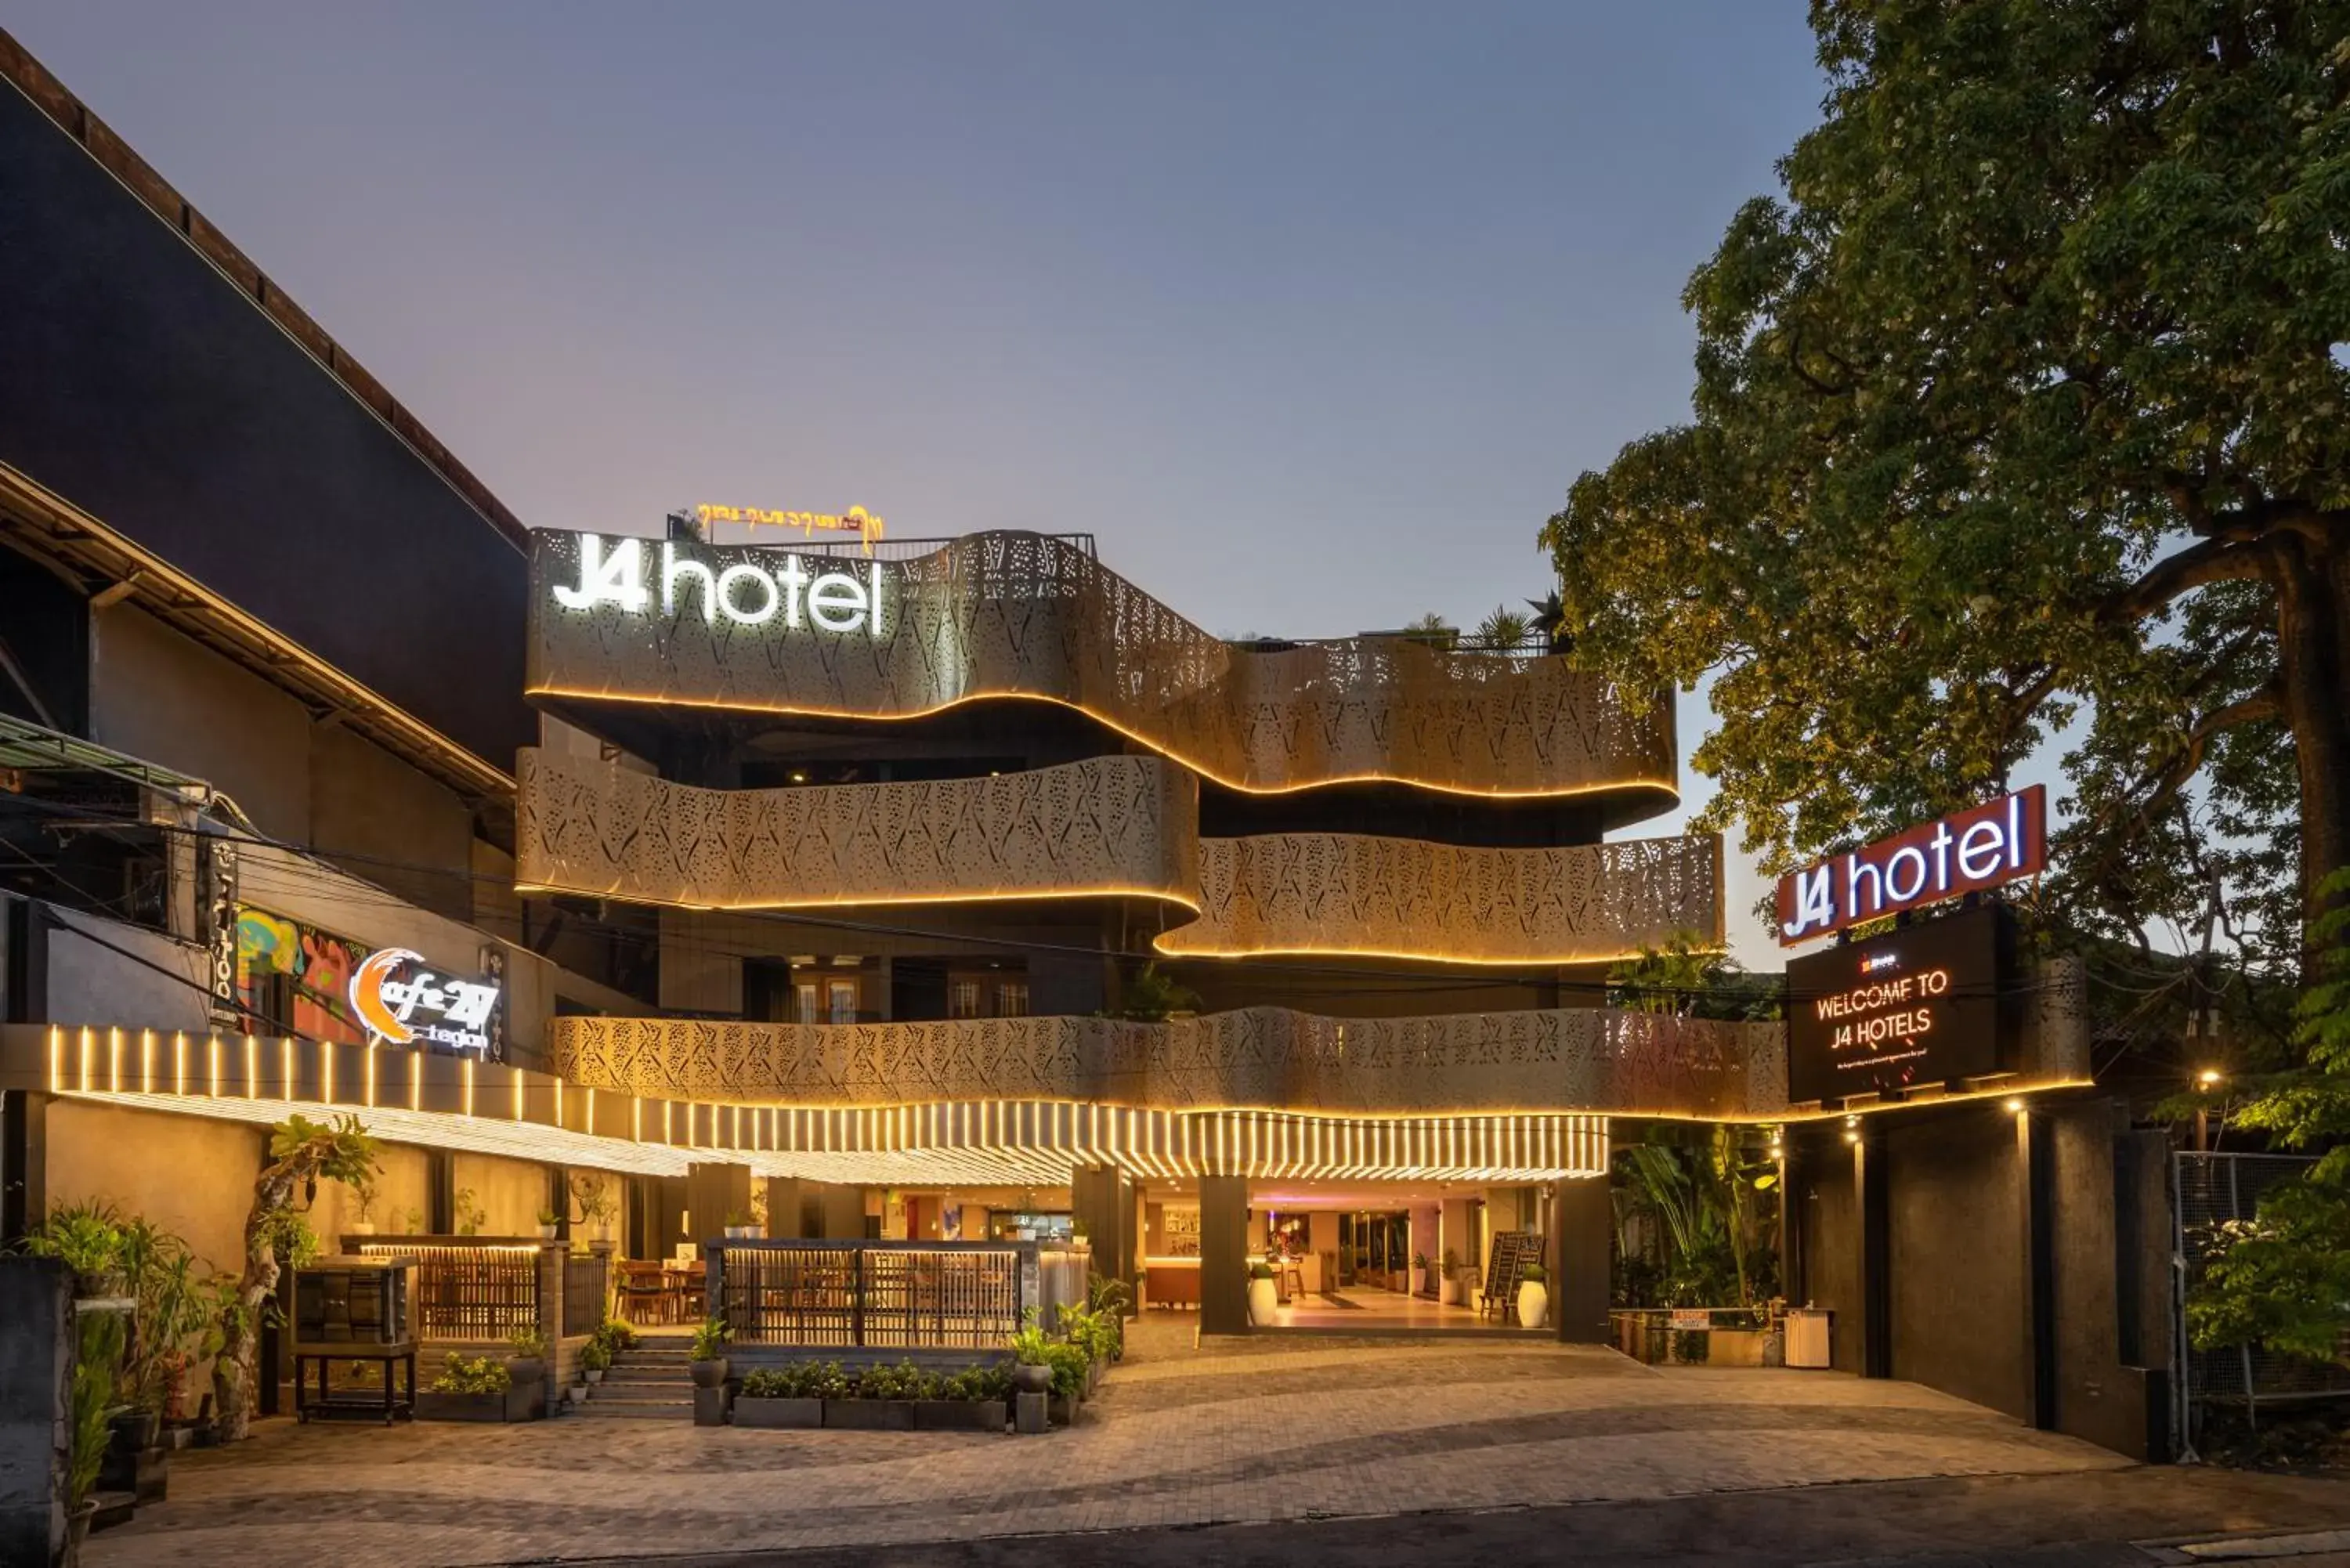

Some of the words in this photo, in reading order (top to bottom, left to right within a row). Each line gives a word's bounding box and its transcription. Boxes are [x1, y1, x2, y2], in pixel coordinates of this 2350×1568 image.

[552, 533, 648, 612] J4
[663, 541, 882, 634] hotel
[1784, 865, 1834, 938] J4
[1849, 796, 2020, 918] hotel
[1817, 978, 1912, 1021] WELCOME
[1918, 970, 1948, 997] TO
[1831, 1023, 1852, 1049] J4
[1857, 1009, 1932, 1043] HOTELS
